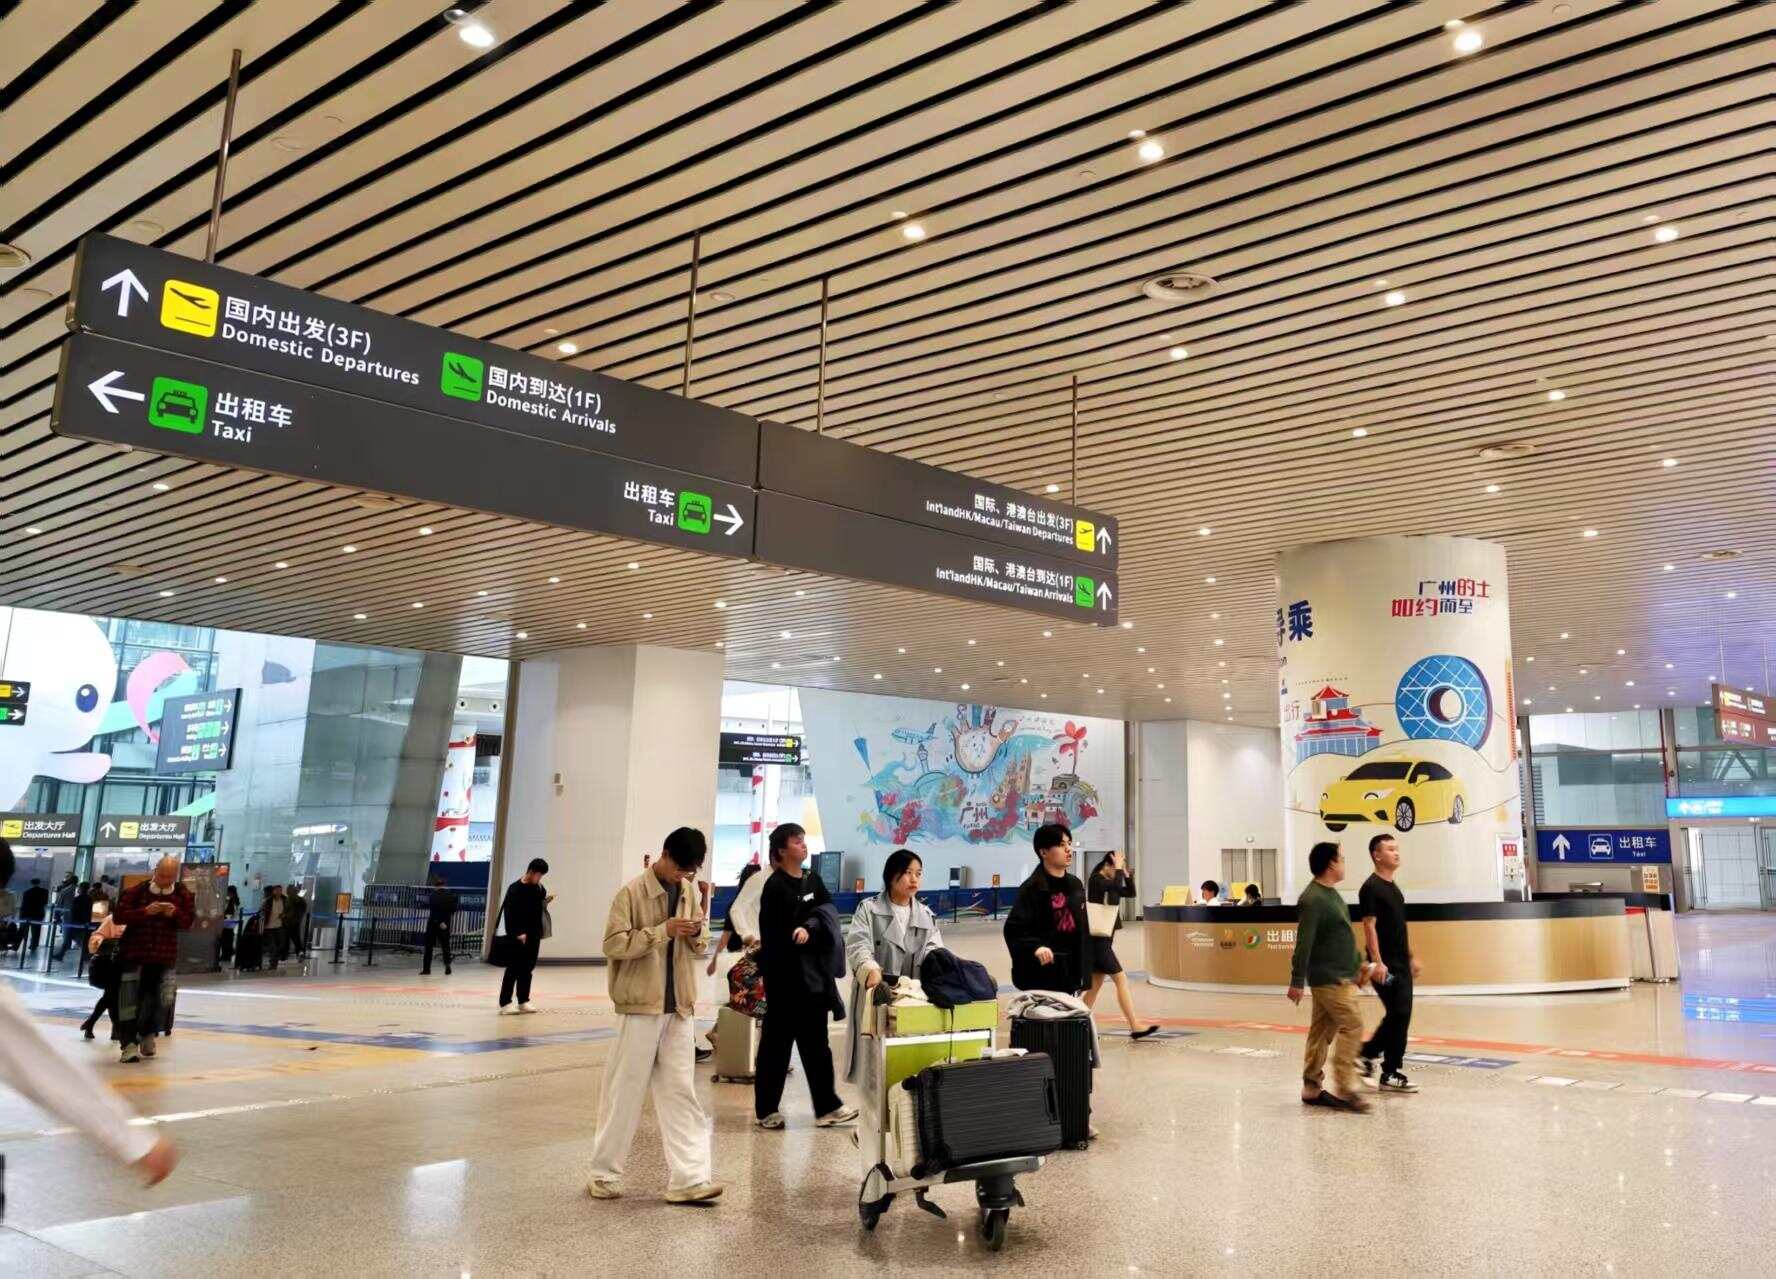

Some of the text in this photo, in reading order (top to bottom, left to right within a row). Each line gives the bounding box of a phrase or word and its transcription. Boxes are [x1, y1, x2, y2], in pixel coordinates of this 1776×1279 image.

[225, 296, 371, 355] 国内出发(3F)
[222, 323, 420, 386] Domestic Departures
[488, 366, 601, 414] 国内到达(1F)
[215, 391, 293, 428] 出租车
[486, 389, 616, 434] Domestic Arrivals
[212, 420, 252, 443] Taxi
[623, 481, 675, 508] 出租车
[647, 509, 674, 527] Taxi
[1032, 526, 1073, 545] Departures
[1044, 589, 1073, 604] Arrivals
[1419, 578, 1491, 598] 广州的士
[1391, 598, 1473, 617] 如约而至
[22, 831, 76, 840] Departures Hall
[24, 821, 66, 832] 出发大厅
[139, 832, 173, 841] Departures
[1619, 836, 1657, 849] 出租车
